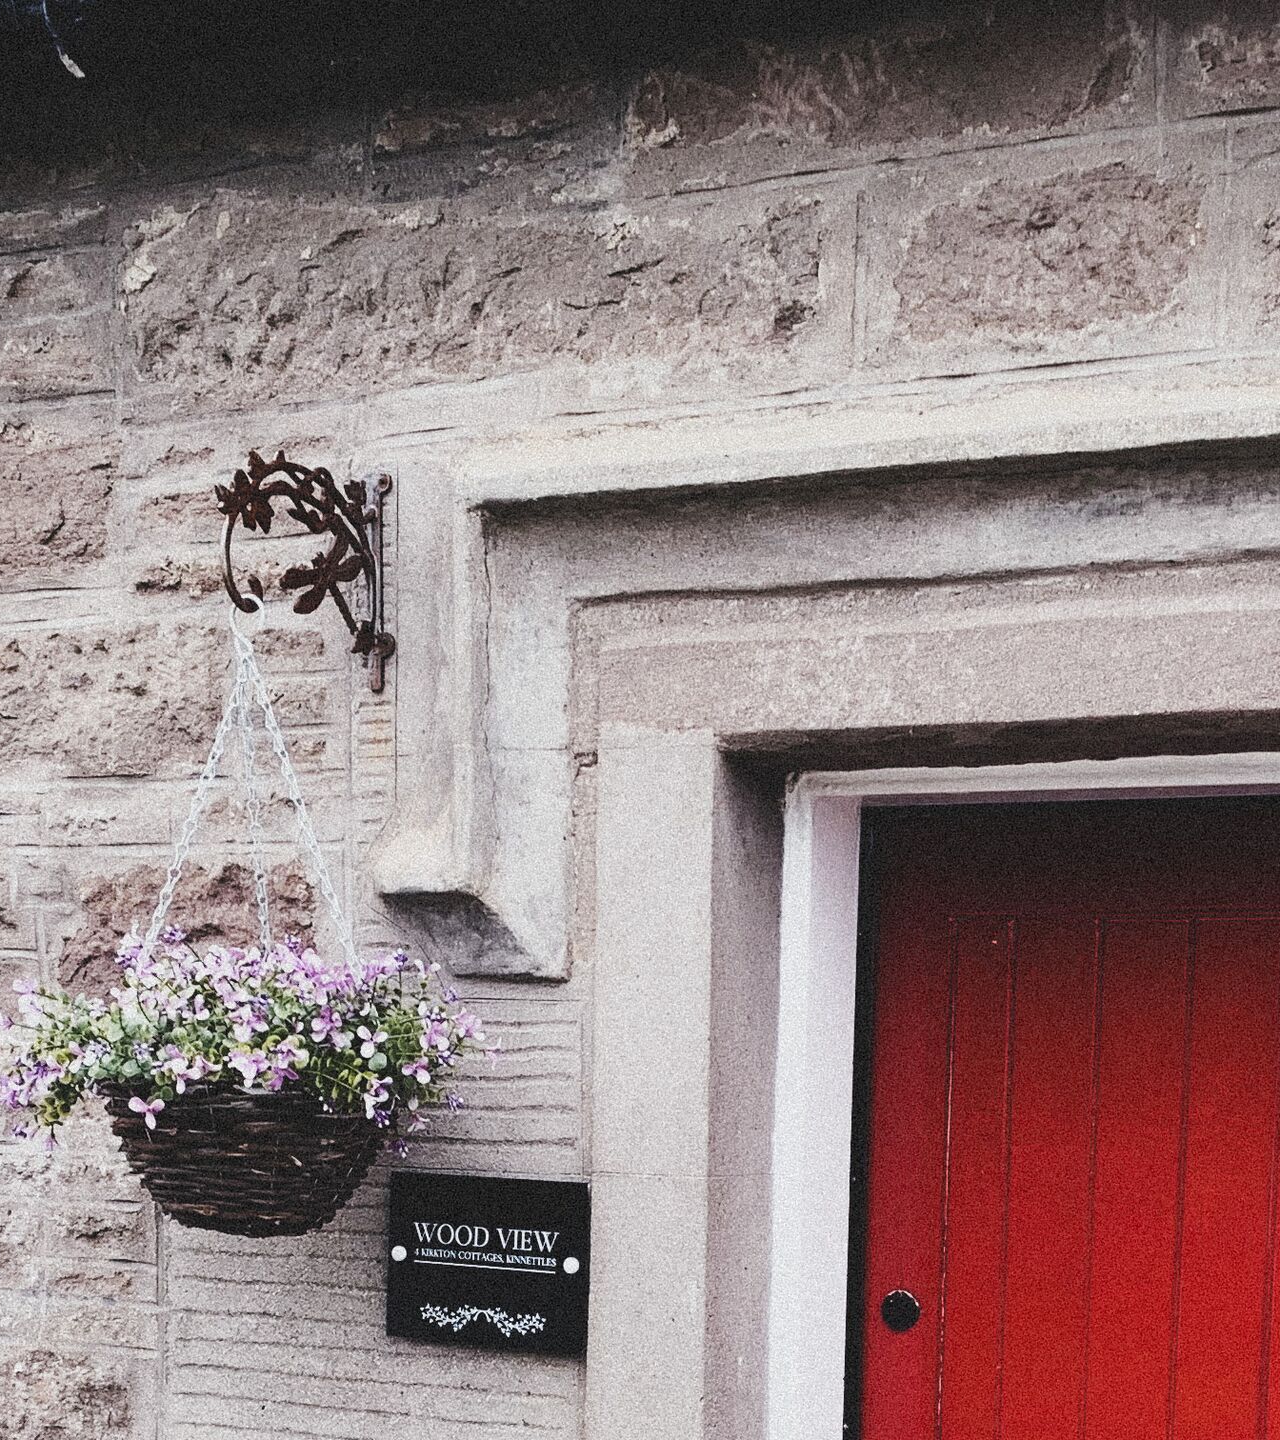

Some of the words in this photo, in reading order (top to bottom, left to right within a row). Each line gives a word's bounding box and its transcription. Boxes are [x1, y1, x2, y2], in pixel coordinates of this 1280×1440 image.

[414, 1222, 490, 1247] WOOD
[497, 1228, 560, 1253] VIEW
[421, 1248, 457, 1260] KIRKTON
[506, 1254, 557, 1267] KINNETTLES
